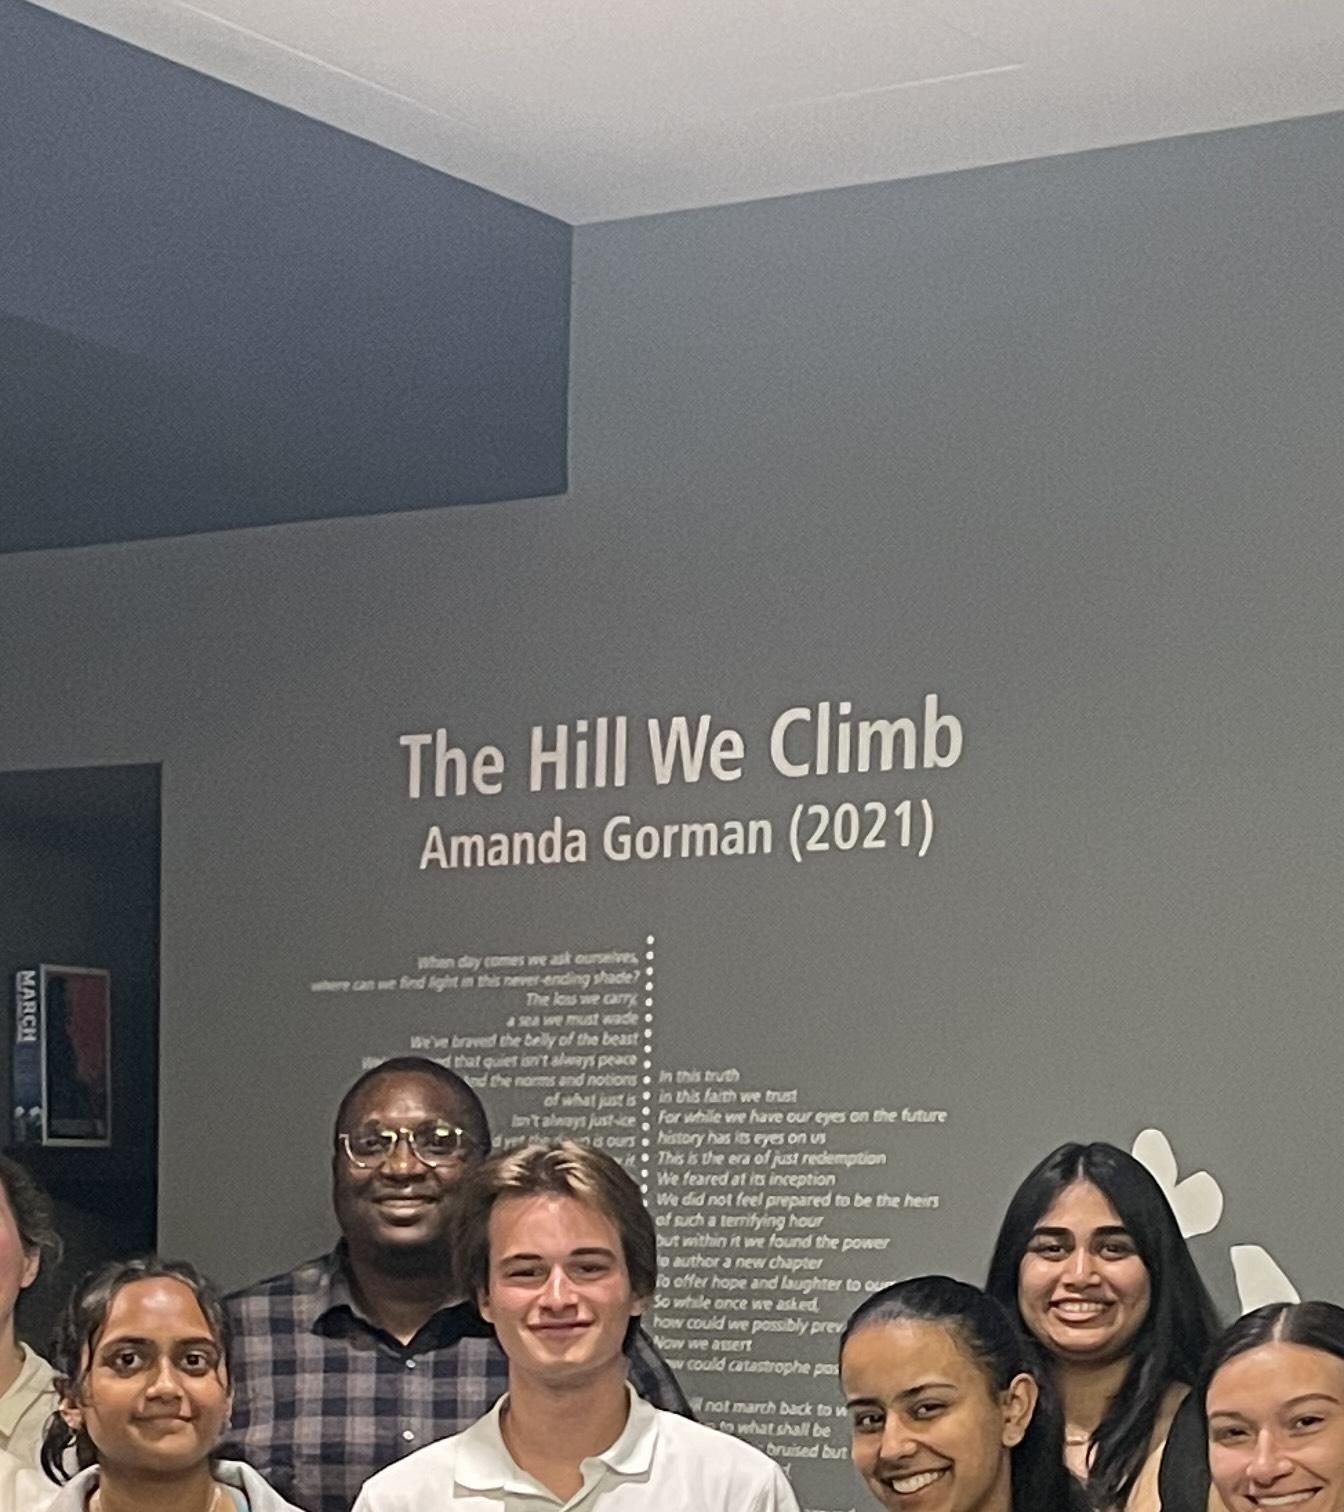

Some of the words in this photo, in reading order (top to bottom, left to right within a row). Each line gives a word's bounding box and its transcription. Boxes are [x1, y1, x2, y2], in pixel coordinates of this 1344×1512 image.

[399, 728, 505, 799] The
[530, 716, 627, 792] Hill
[647, 714, 745, 785] We
[770, 693, 964, 778] Climb
[419, 816, 587, 870] Amanda
[603, 815, 773, 860] Gorman
[789, 798, 934, 863] (2021)
[417, 954, 455, 969] When
[457, 954, 481, 972] day
[483, 957, 525, 968] comes
[549, 952, 571, 967] ask
[377, 979, 396, 990] we
[399, 975, 426, 990] find
[427, 974, 458, 992] light
[476, 973, 501, 988] this
[502, 971, 591, 991] never-ending
[20, 969, 37, 1041] MARCH
[526, 991, 550, 1005] The
[552, 991, 577, 1005] loss
[579, 995, 600, 1005] we
[518, 1016, 540, 1026] sea
[542, 1015, 563, 1026] we
[565, 1011, 599, 1026] must
[601, 1011, 639, 1025] wade
[451, 1033, 496, 1048] braved
[498, 1032, 521, 1047] the
[523, 1032, 556, 1050] belly
[557, 1032, 574, 1046] of
[576, 1031, 599, 1046] the
[601, 1031, 638, 1045] beast
[455, 1053, 481, 1068] that
[482, 1053, 517, 1071] quiet
[550, 1052, 595, 1070] always
[597, 1056, 637, 1070] peace
[489, 1073, 512, 1087] the
[514, 1076, 556, 1087] norms
[558, 1072, 585, 1087] and
[586, 1072, 637, 1086] notions
[675, 1068, 701, 1082] this
[703, 1068, 740, 1082] truth
[561, 1093, 596, 1108] what
[597, 1093, 624, 1111] just
[675, 1088, 701, 1102] this
[739, 1092, 761, 1102] we
[541, 1113, 587, 1131] always
[657, 1109, 680, 1123] For
[683, 1108, 722, 1123] while
[724, 1112, 746, 1122] we
[748, 1108, 783, 1122] have
[785, 1112, 812, 1122] our
[814, 1111, 847, 1125] eyes
[848, 1111, 870, 1122] on
[872, 1108, 898, 1122] the
[900, 1107, 947, 1122] future
[605, 1137, 635, 1147] ours
[657, 1130, 704, 1148] history
[706, 1130, 731, 1144] has
[733, 1130, 751, 1144] its
[752, 1133, 785, 1147] eyes
[786, 1133, 807, 1144] on
[809, 1133, 827, 1144] us
[657, 1151, 684, 1165] This
[701, 1151, 724, 1165] the
[727, 1155, 751, 1165] era
[753, 1151, 770, 1165] of
[772, 1151, 799, 1168] just
[801, 1150, 887, 1168] redemption
[656, 1171, 679, 1185] We
[682, 1171, 729, 1185] feared
[749, 1171, 766, 1185] its
[768, 1171, 836, 1189] inception
[656, 1192, 679, 1206] We
[681, 1192, 705, 1206] did
[707, 1192, 732, 1206] not
[735, 1192, 763, 1206] feel
[765, 1192, 831, 1210] prepared
[834, 1193, 851, 1207] to
[852, 1193, 872, 1207] be
[875, 1193, 901, 1207] the
[903, 1193, 940, 1207] heirs
[673, 1212, 705, 1227] such
[787, 1213, 823, 1227] hour
[655, 1233, 679, 1247] but
[681, 1233, 727, 1248] within
[743, 1237, 765, 1248] we
[768, 1234, 812, 1248] found
[814, 1234, 839, 1248] the
[841, 1238, 890, 1252] power
[672, 1254, 719, 1268] author
[734, 1258, 766, 1268] new
[767, 1254, 823, 1272] chapter
[672, 1274, 707, 1289] offer
[710, 1275, 747, 1293] hope
[750, 1275, 778, 1290] and
[779, 1276, 842, 1294] laughter
[844, 1277, 862, 1291] to
[672, 1295, 711, 1310] while
[713, 1299, 748, 1310] once
[750, 1300, 773, 1311] we
[654, 1315, 683, 1330] how
[685, 1316, 725, 1330] could
[727, 1320, 749, 1330] we
[655, 1336, 684, 1350] Now
[686, 1340, 709, 1351] we
[687, 1357, 726, 1371] could
[704, 1397, 730, 1412] not
[732, 1398, 776, 1414] march
[778, 1400, 812, 1415] back
[815, 1402, 832, 1416] to
[737, 1420, 774, 1435] what
[775, 1421, 810, 1435] shall
[811, 1421, 831, 1435] be
[821, 1443, 848, 1457] but
